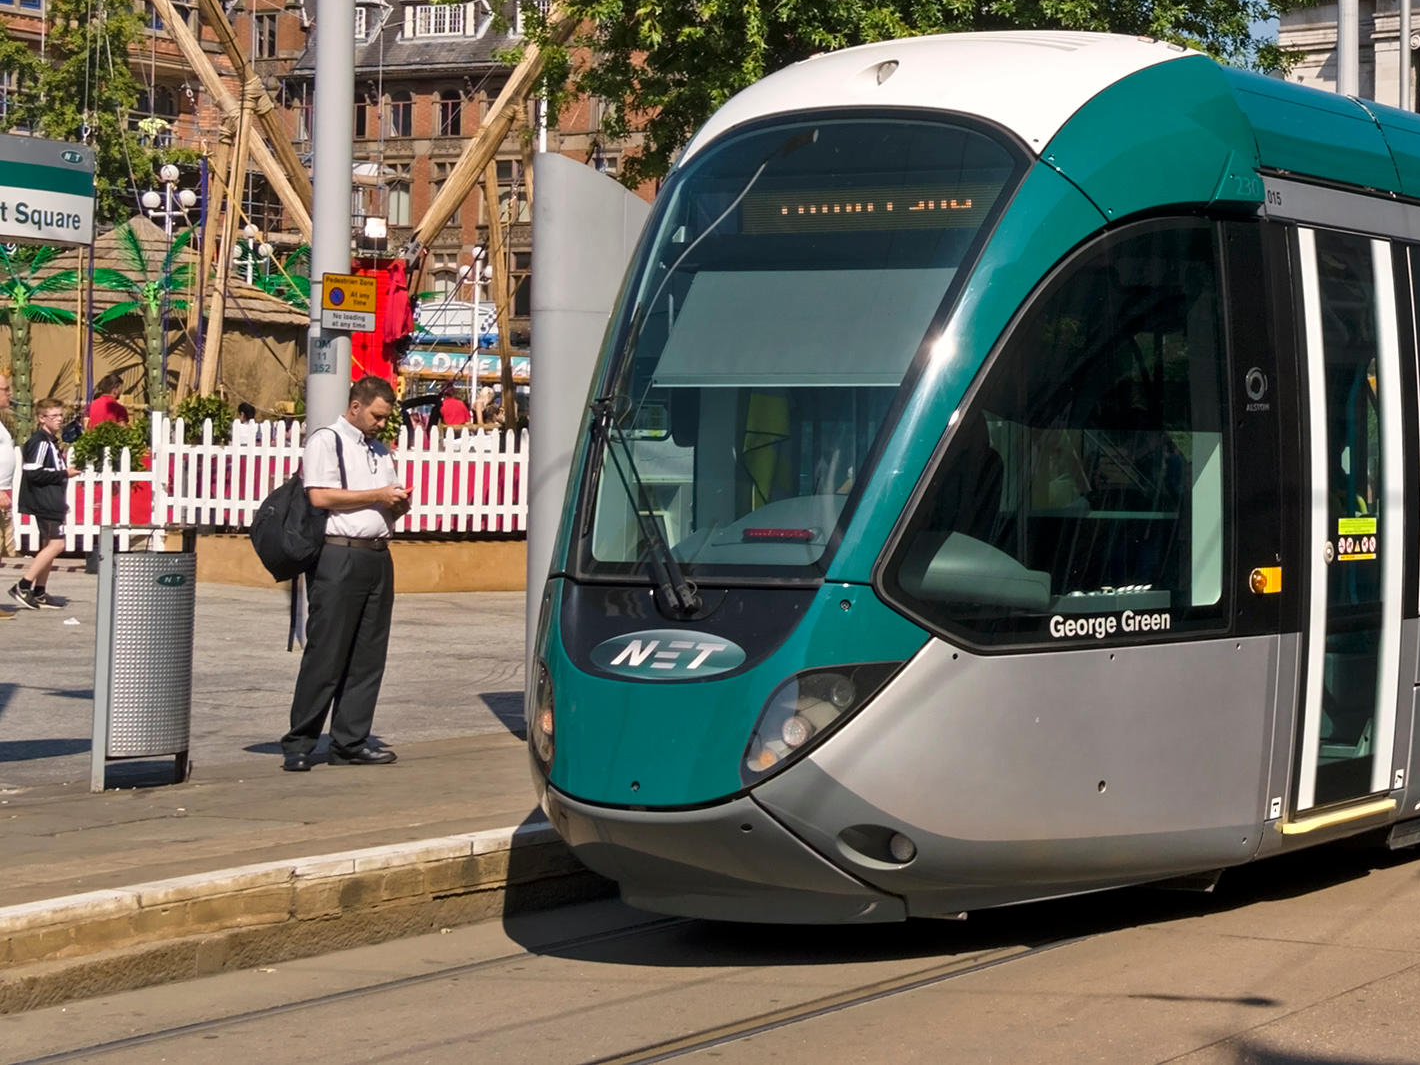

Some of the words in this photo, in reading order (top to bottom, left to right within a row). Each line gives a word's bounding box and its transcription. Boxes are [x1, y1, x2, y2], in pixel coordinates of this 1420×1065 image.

[64, 152, 80, 161] NT
[1267, 189, 1282, 206] 015
[15, 201, 81, 231] Square
[326, 276, 358, 285] Pedestrian
[343, 313, 366, 322] loading
[1050, 615, 1117, 639] George
[1121, 609, 1171, 632] Green
[609, 639, 729, 670] NET
